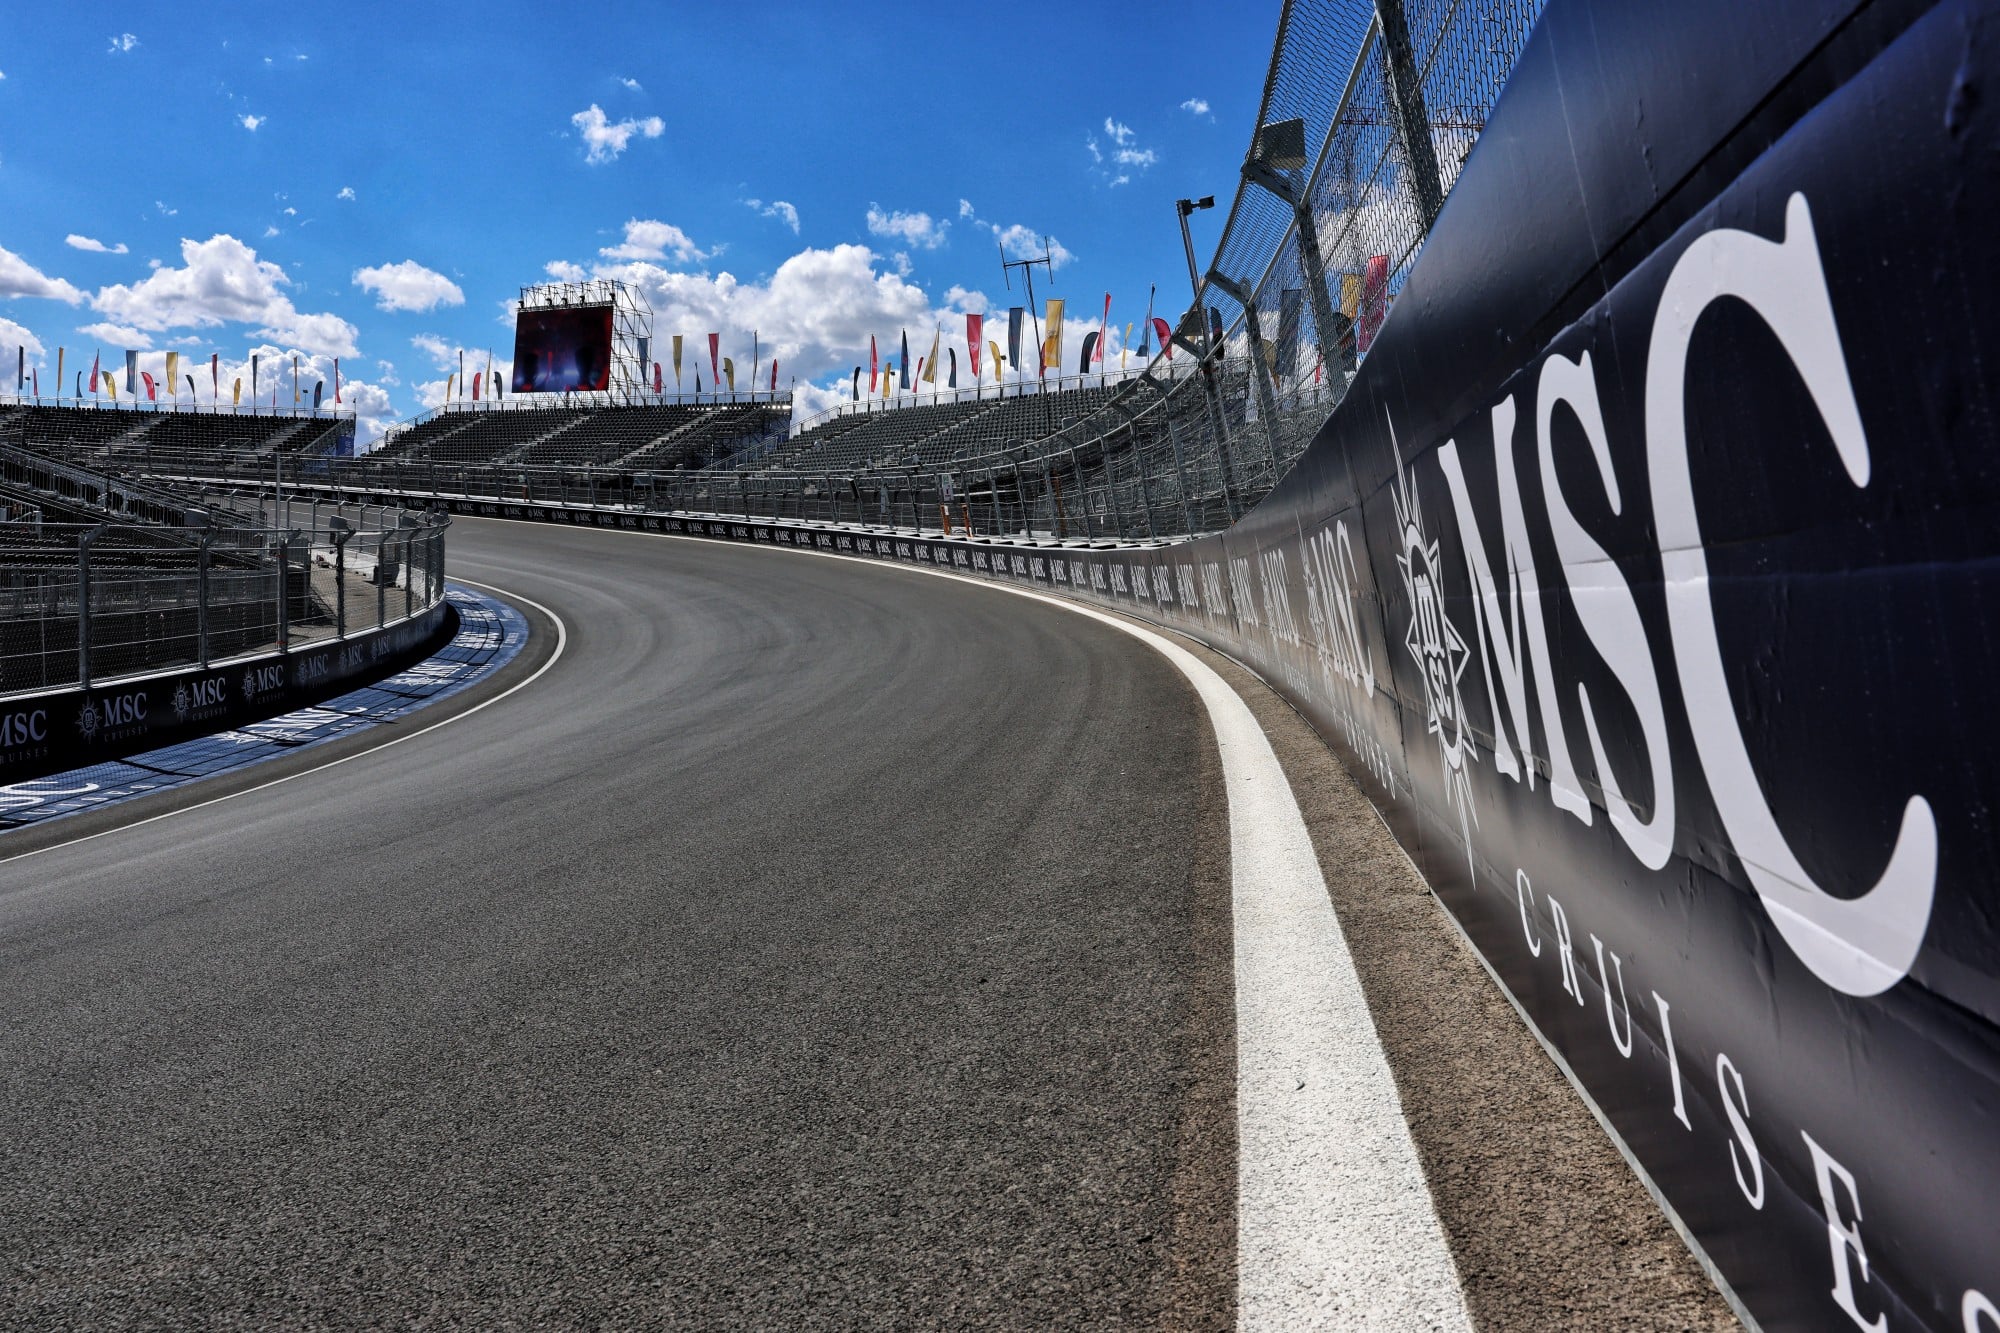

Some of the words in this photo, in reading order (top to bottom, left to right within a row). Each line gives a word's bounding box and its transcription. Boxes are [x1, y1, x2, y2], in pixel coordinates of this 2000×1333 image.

[1438, 191, 1937, 997] MSC
[257, 664, 284, 692] MSC
[308, 653, 328, 680] MSC
[192, 677, 226, 708] MSC
[104, 692, 148, 728] MSC
